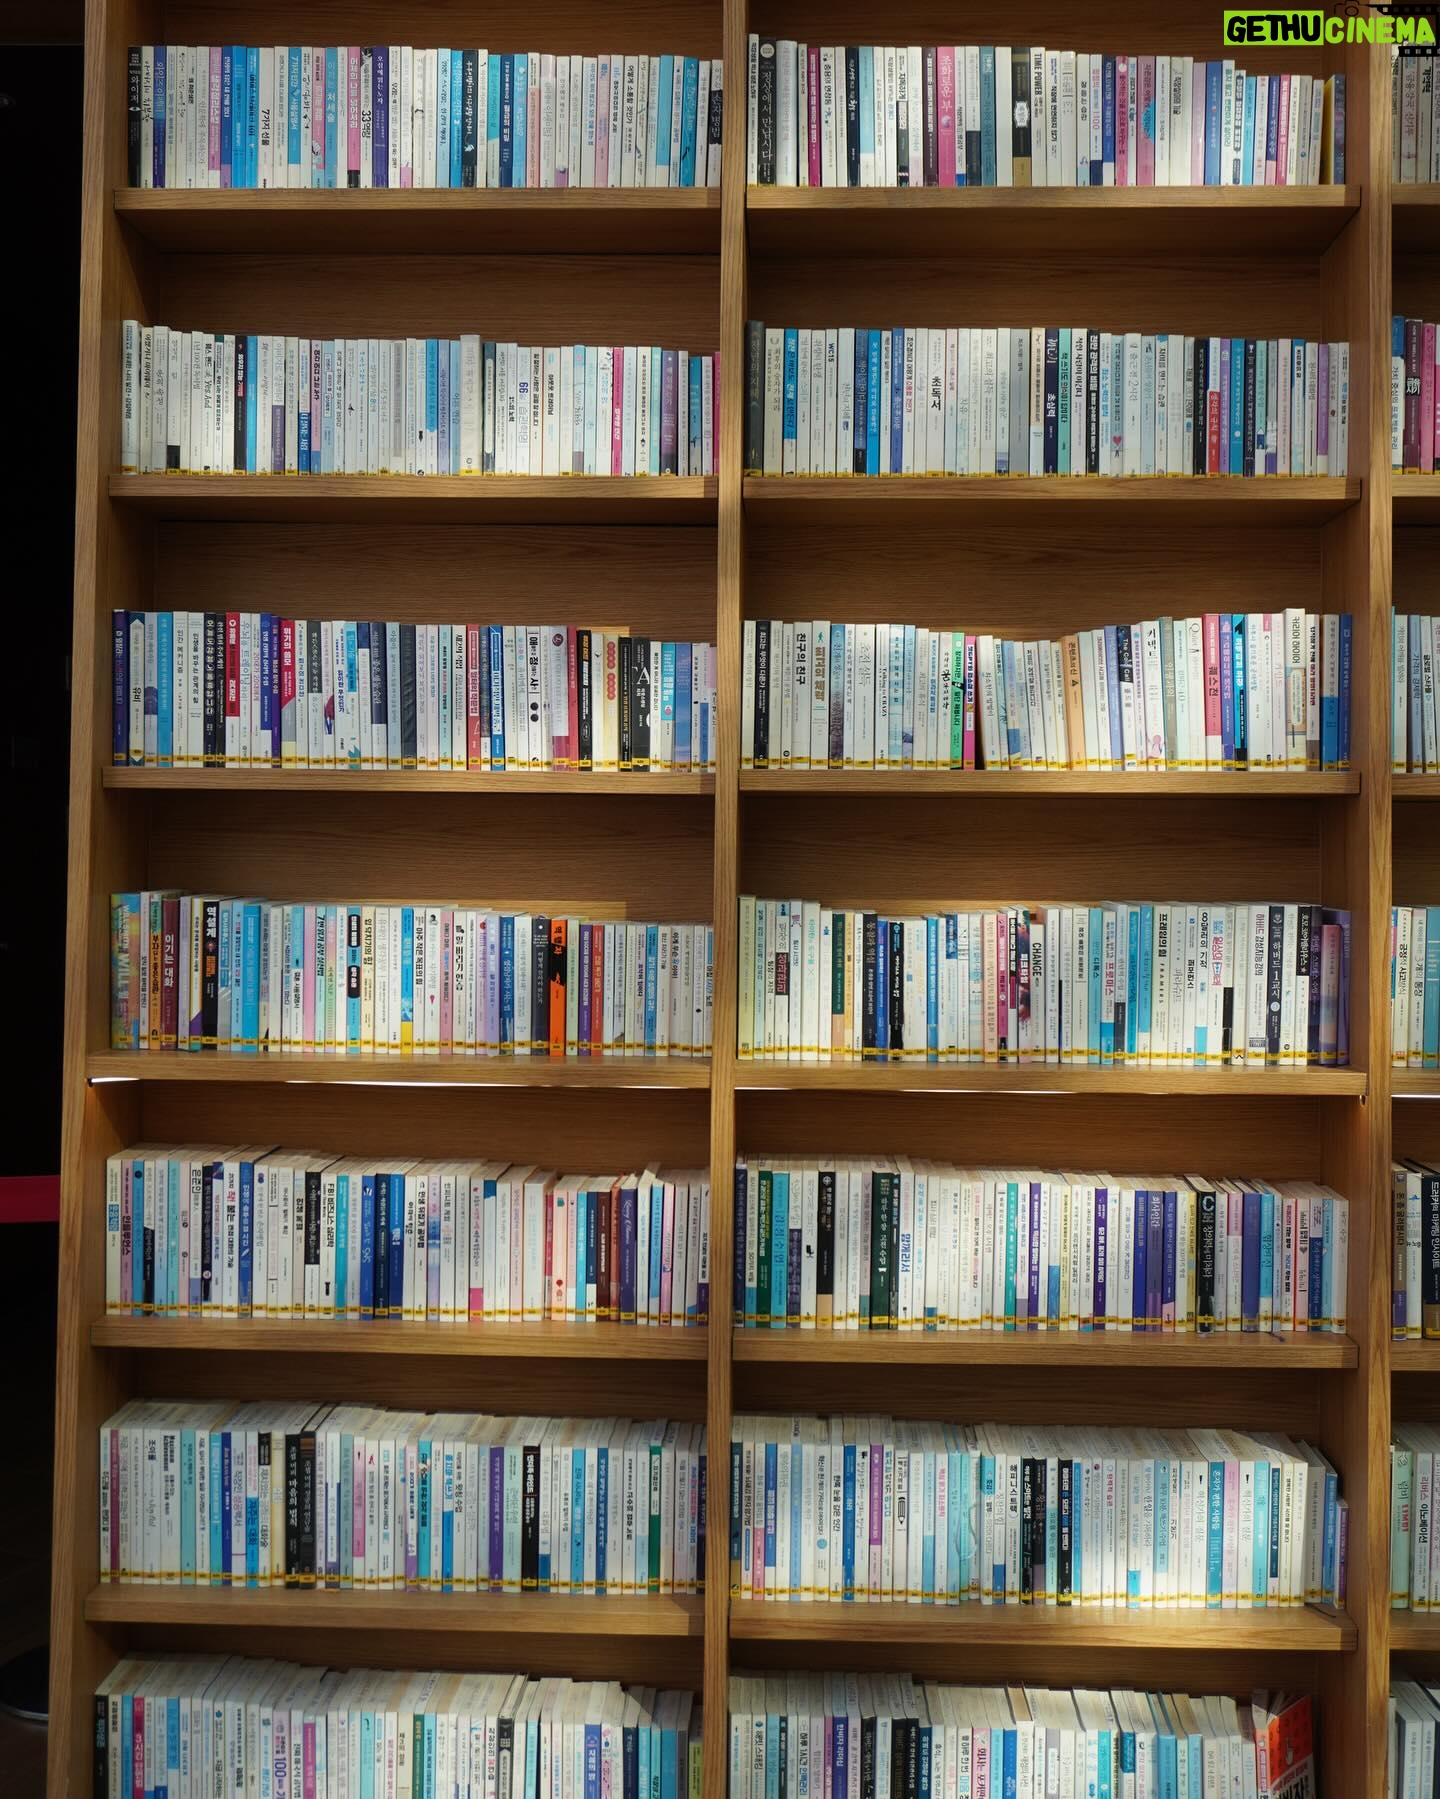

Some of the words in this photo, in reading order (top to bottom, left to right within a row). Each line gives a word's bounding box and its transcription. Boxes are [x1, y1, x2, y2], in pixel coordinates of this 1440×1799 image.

[1034, 53, 1042, 70] TIME
[1034, 72, 1042, 96] POWER
[261, 109, 270, 130] 7가지
[261, 131, 270, 146] 선물
[518, 382, 528, 393] 66
[931, 376, 942, 411] 초독서
[1047, 392, 1056, 417] 초심력
[796, 632, 807, 663] 친구의
[796, 666, 807, 686] 친구
[1158, 913, 1168, 948] 프레임의
[163, 934, 174, 964] 이기는
[1032, 942, 1042, 976] CHANGE
[1272, 942, 1281, 968] 하버드
[163, 967, 174, 988] 대화
[1105, 962, 1115, 996] 프로미스
[326, 1183, 334, 1196] FBI
[326, 1197, 334, 1224] 비즈니스
[1151, 1196, 1160, 1227] 회사인간
[326, 1226, 334, 1248] 심리학
[274, 1757, 287, 1778] 100
